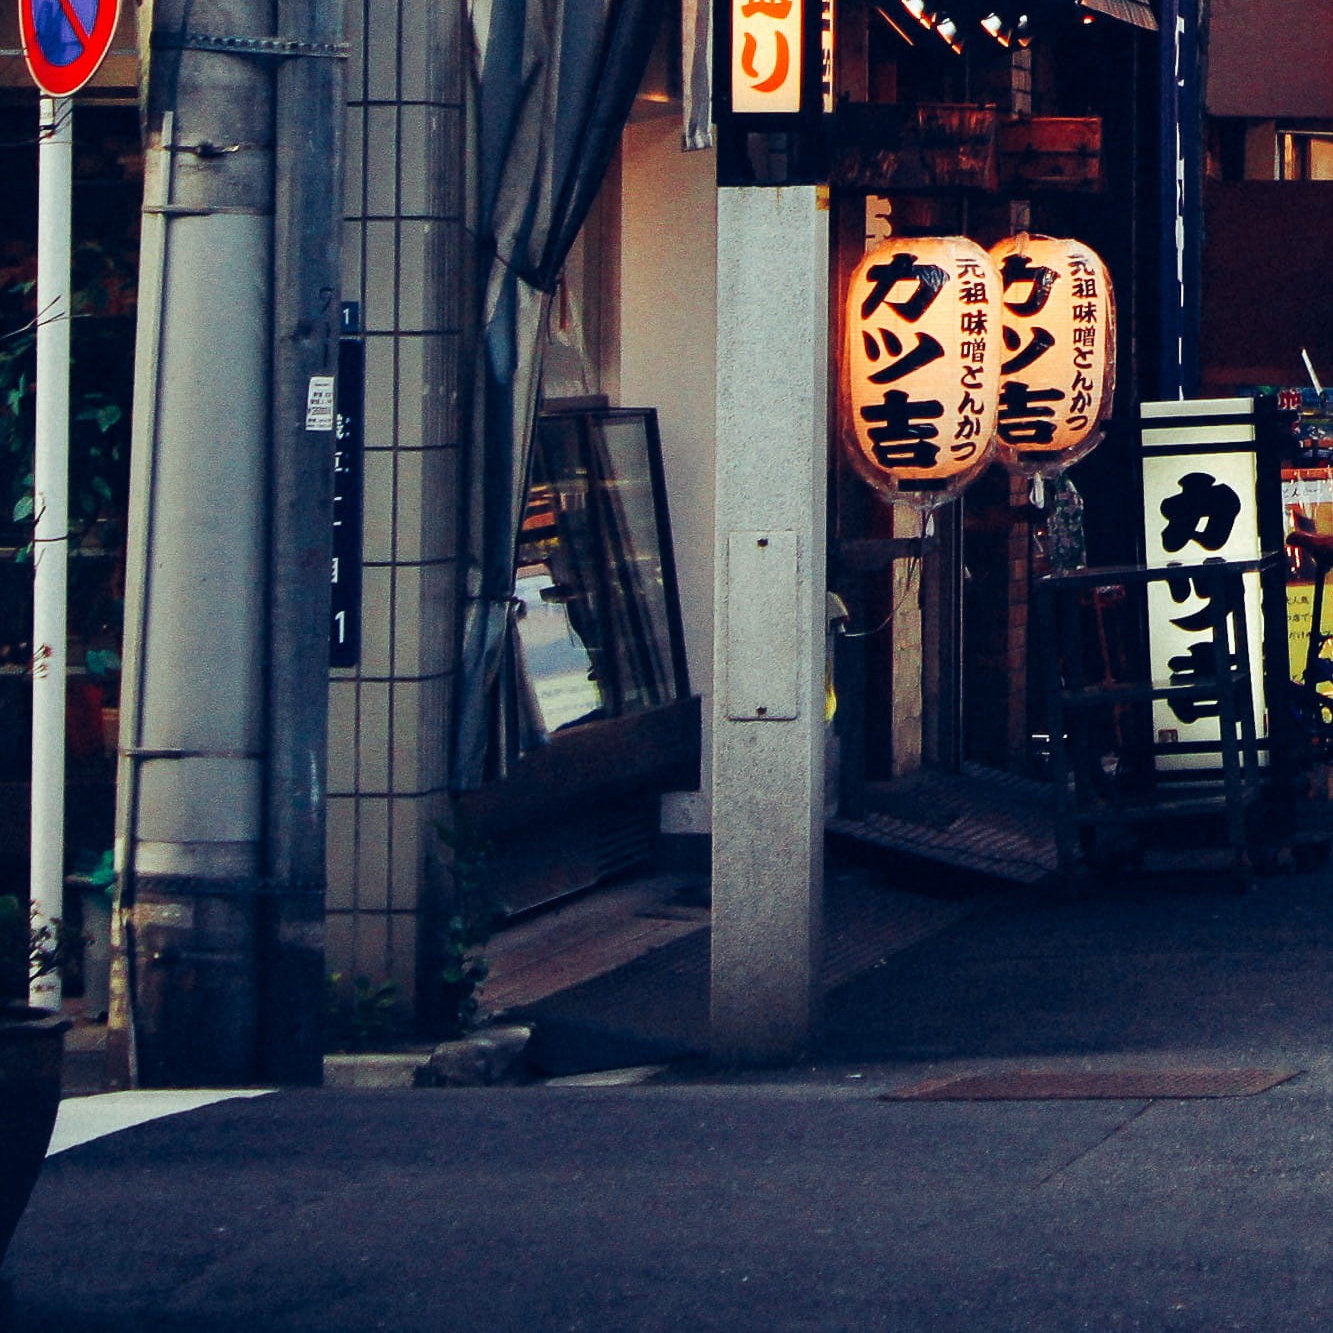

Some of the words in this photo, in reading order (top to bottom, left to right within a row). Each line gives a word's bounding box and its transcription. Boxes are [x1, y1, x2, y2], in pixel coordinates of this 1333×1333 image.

[860, 252, 951, 470] カツ吉
[949, 258, 989, 462] 元祖味噌とんかつ
[1064, 254, 1099, 432] 元祖味噌とんかつ
